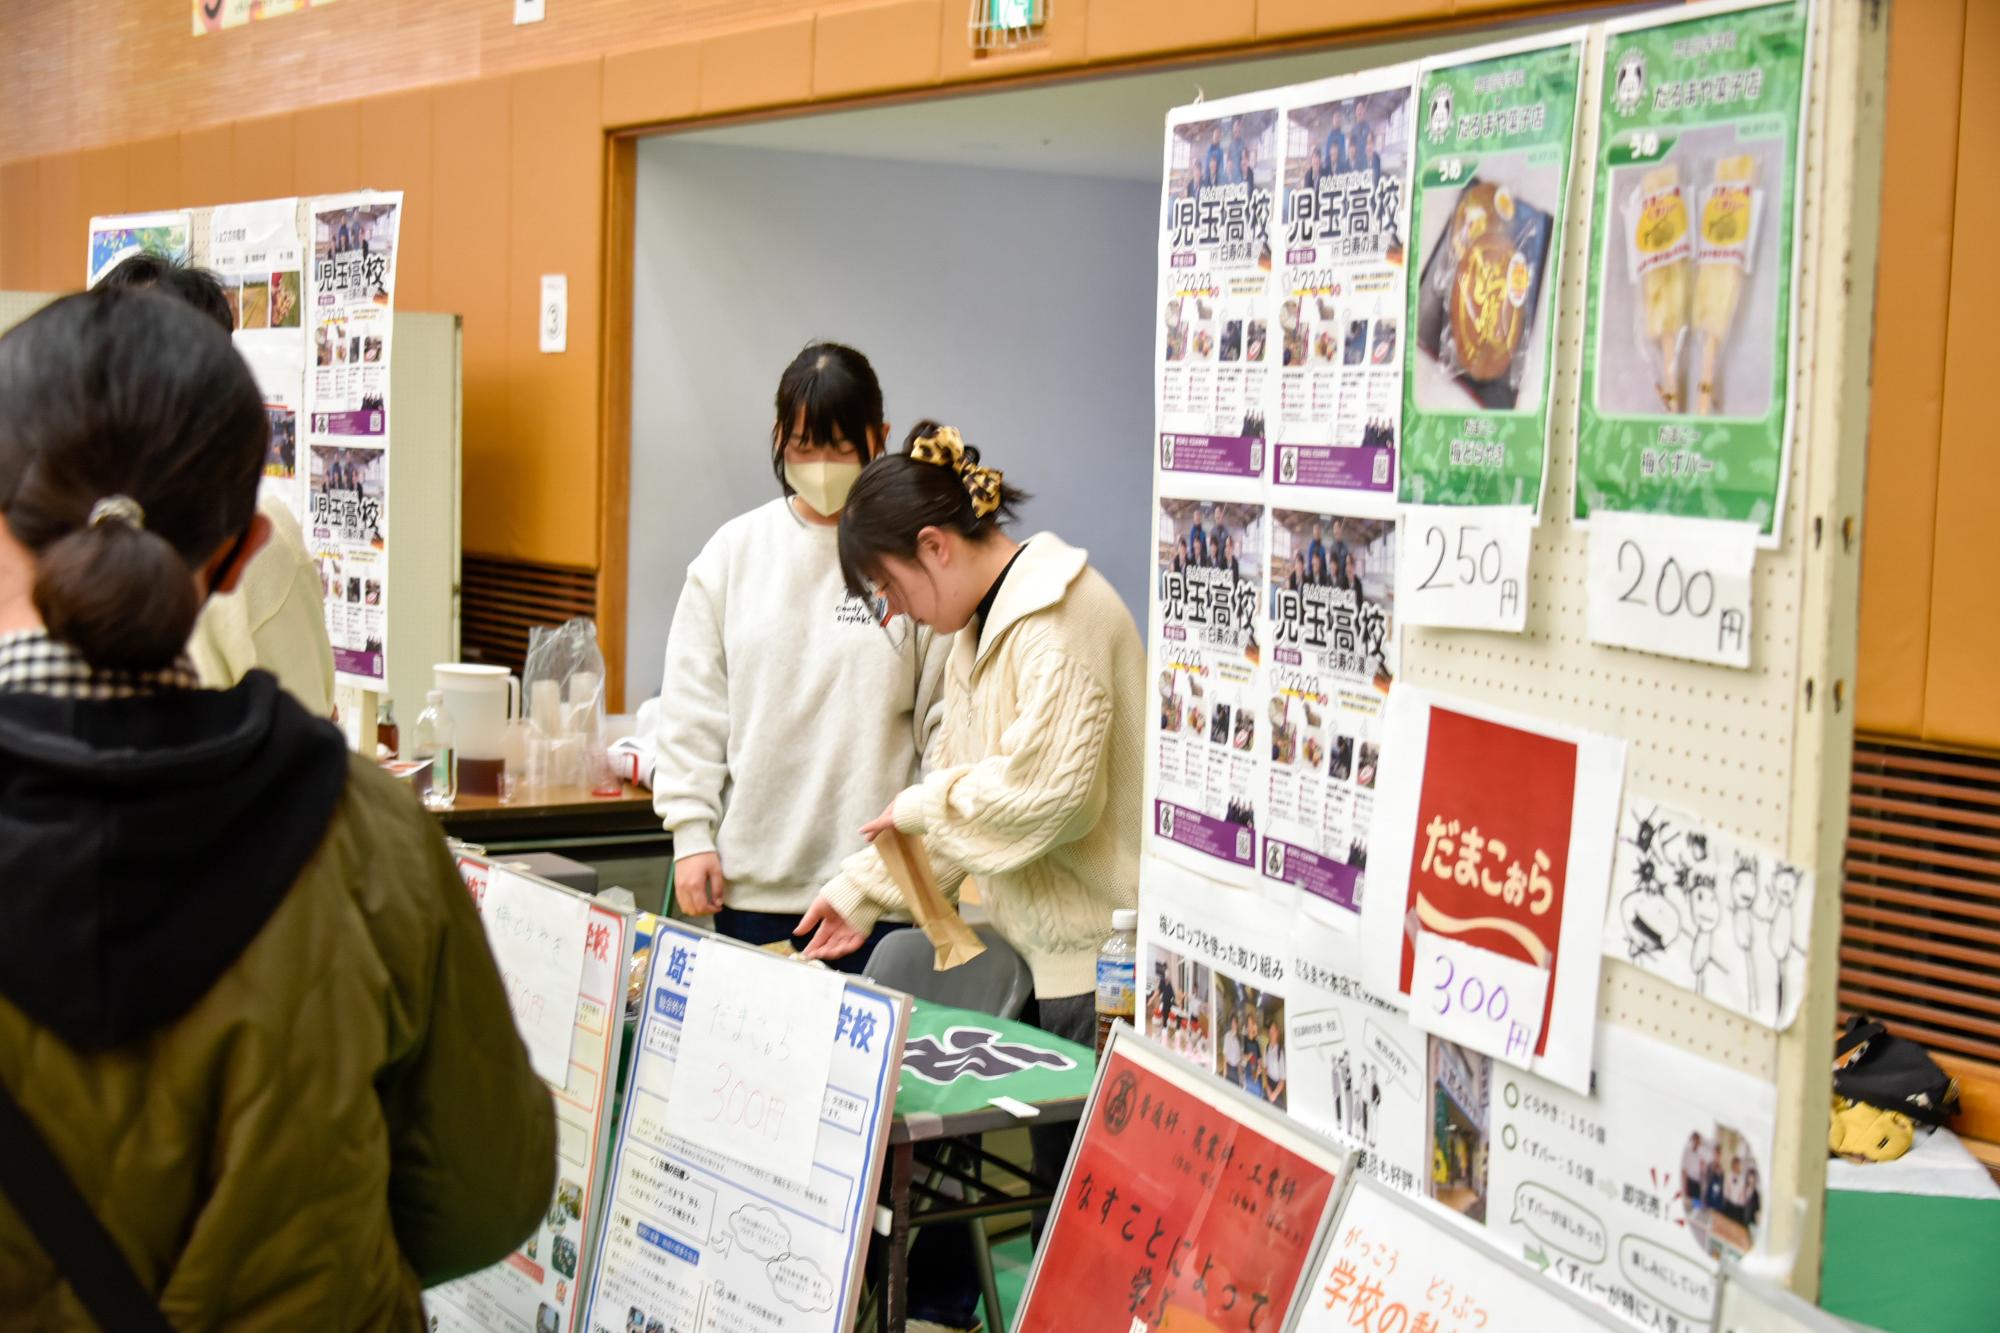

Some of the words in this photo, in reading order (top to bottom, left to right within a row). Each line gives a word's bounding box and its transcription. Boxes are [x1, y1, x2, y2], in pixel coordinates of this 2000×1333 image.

[1172, 190, 1272, 247] 児玉高校
[1289, 180, 1400, 243] 児玉高校
[319, 256, 386, 293] 児玉高校
[315, 498, 380, 528] 児玉高校
[1416, 526, 1519, 618] 250円
[1618, 540, 1745, 653] 200円
[1163, 573, 1256, 636] 児玉高校
[1276, 594, 1386, 656] 児玉高校
[1432, 953, 1532, 1059] 300円
[704, 1061, 788, 1142] 300円
